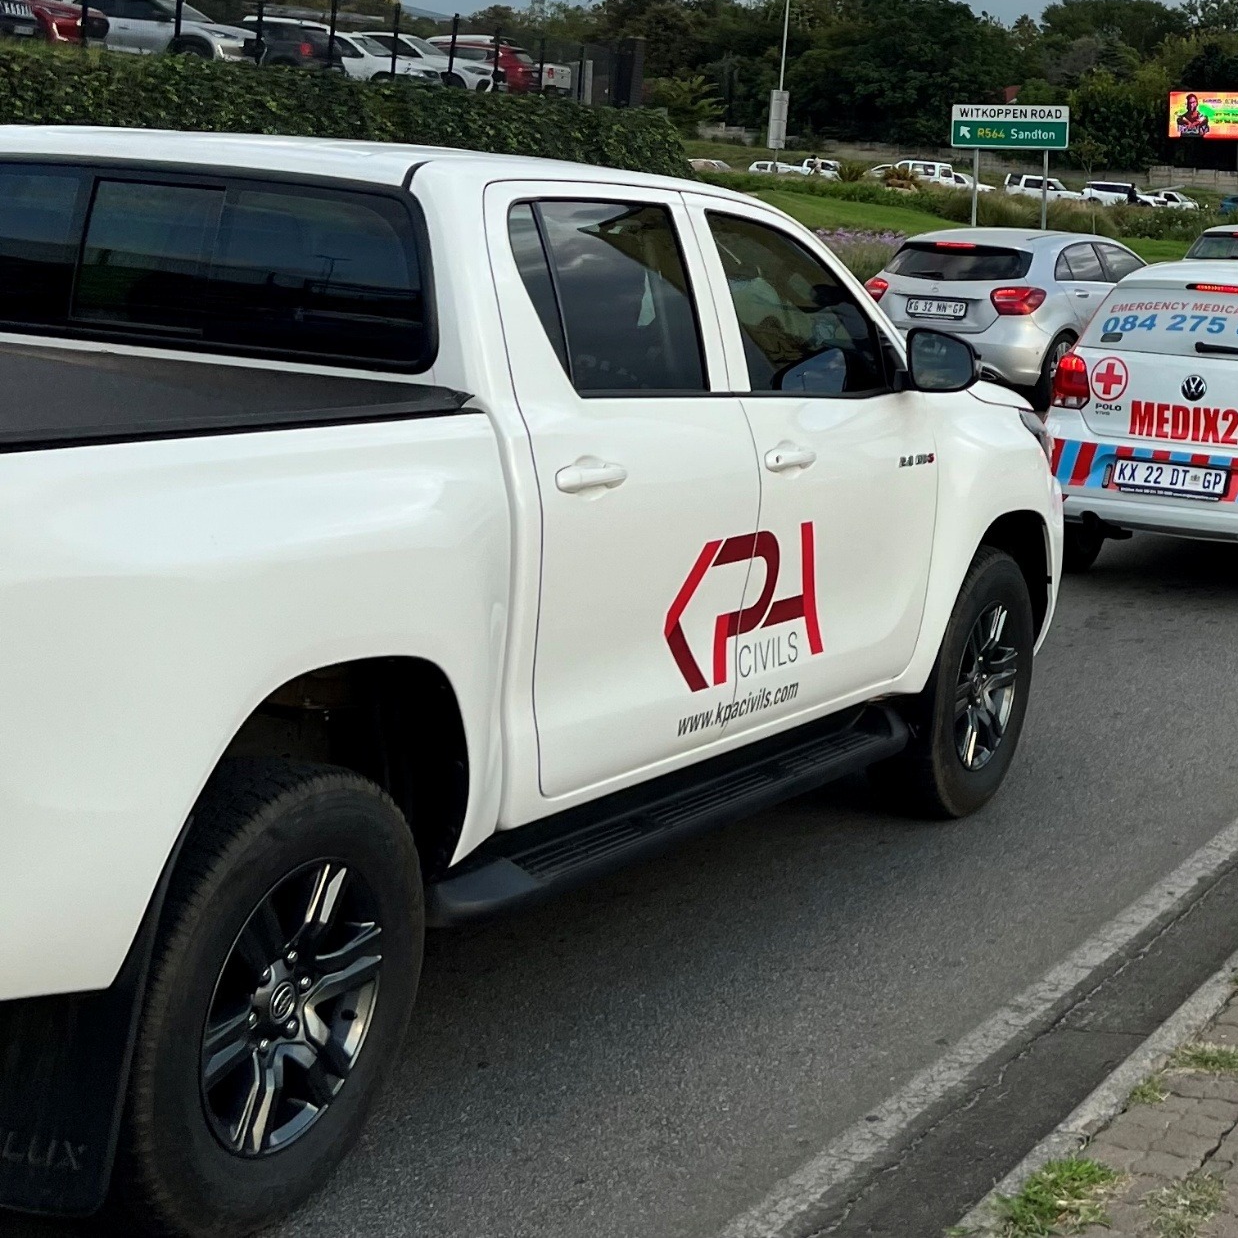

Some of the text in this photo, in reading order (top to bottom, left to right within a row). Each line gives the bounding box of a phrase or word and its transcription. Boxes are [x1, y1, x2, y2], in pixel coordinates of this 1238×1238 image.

[959, 107, 1062, 120] WITKOPPEN ROAD
[977, 127, 1056, 140] R564 Sandton
[922, 301, 934, 313] 32
[952, 303, 965, 315] GP
[1110, 301, 1189, 314] EMERGENCY
[1101, 313, 1159, 335] 084
[1165, 313, 1228, 335] 275
[1094, 402, 1122, 412] POLO
[1117, 462, 1222, 491] KX 22 DT GP
[737, 630, 799, 679] CIVILS
[676, 681, 800, 738] www.kpacivils.com
